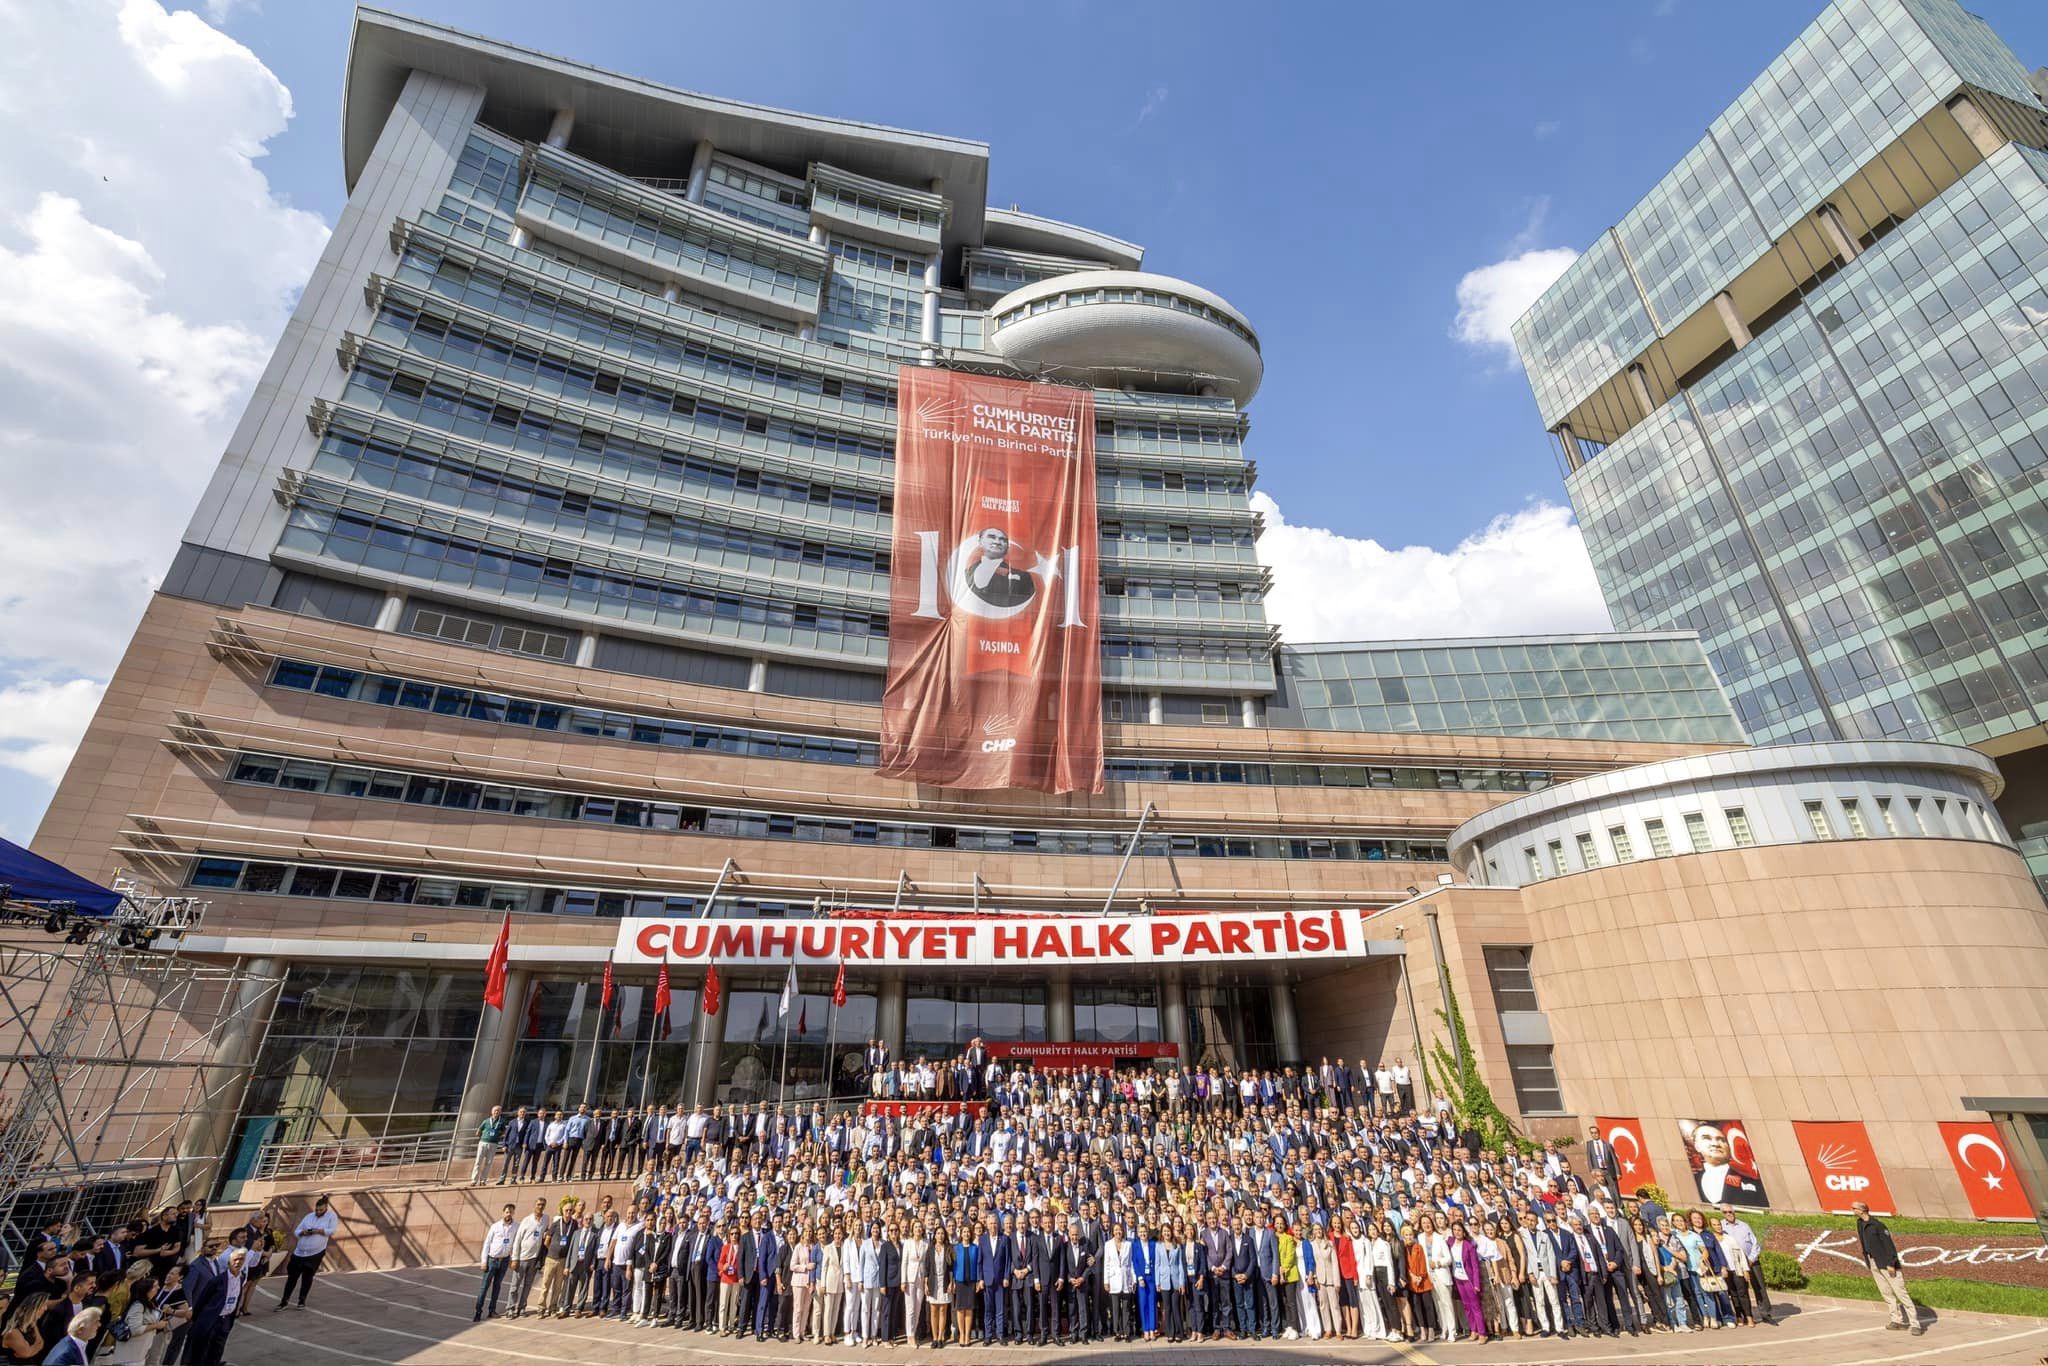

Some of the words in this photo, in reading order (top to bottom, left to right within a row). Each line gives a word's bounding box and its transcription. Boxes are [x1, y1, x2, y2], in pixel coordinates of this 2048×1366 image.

[973, 416, 1018, 434] HALK
[923, 428, 994, 446] Türkiye'nin
[998, 438, 1037, 453] Birinci
[979, 639, 1021, 655] YAŞINDA
[982, 738, 1016, 753] CHP
[636, 920, 976, 959] CUMHURİYET
[994, 924, 1134, 958] HALK
[1150, 910, 1348, 957] PARTİSİ
[1010, 1045, 1071, 1055] CUMHURİYET
[1074, 1046, 1099, 1055] HALK
[1102, 1044, 1137, 1055] PARTİSİ
[1825, 1174, 1870, 1191] CHP
